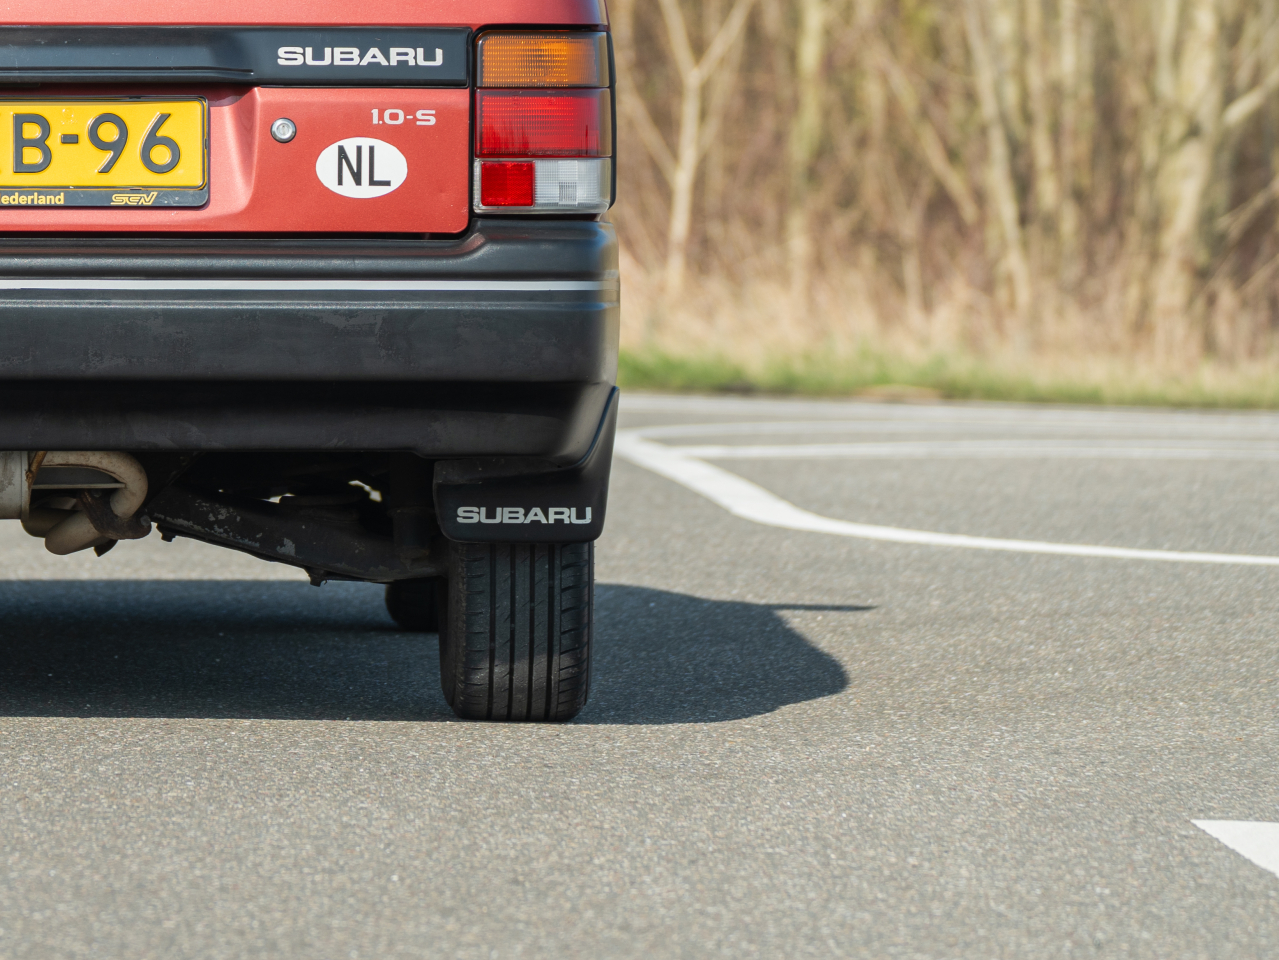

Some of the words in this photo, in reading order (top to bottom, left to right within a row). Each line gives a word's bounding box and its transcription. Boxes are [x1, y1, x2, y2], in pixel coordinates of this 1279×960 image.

[277, 46, 443, 66] SUBARU
[371, 108, 437, 125] 1.0-S
[336, 144, 392, 187] NL
[456, 506, 592, 524] SUBARU
